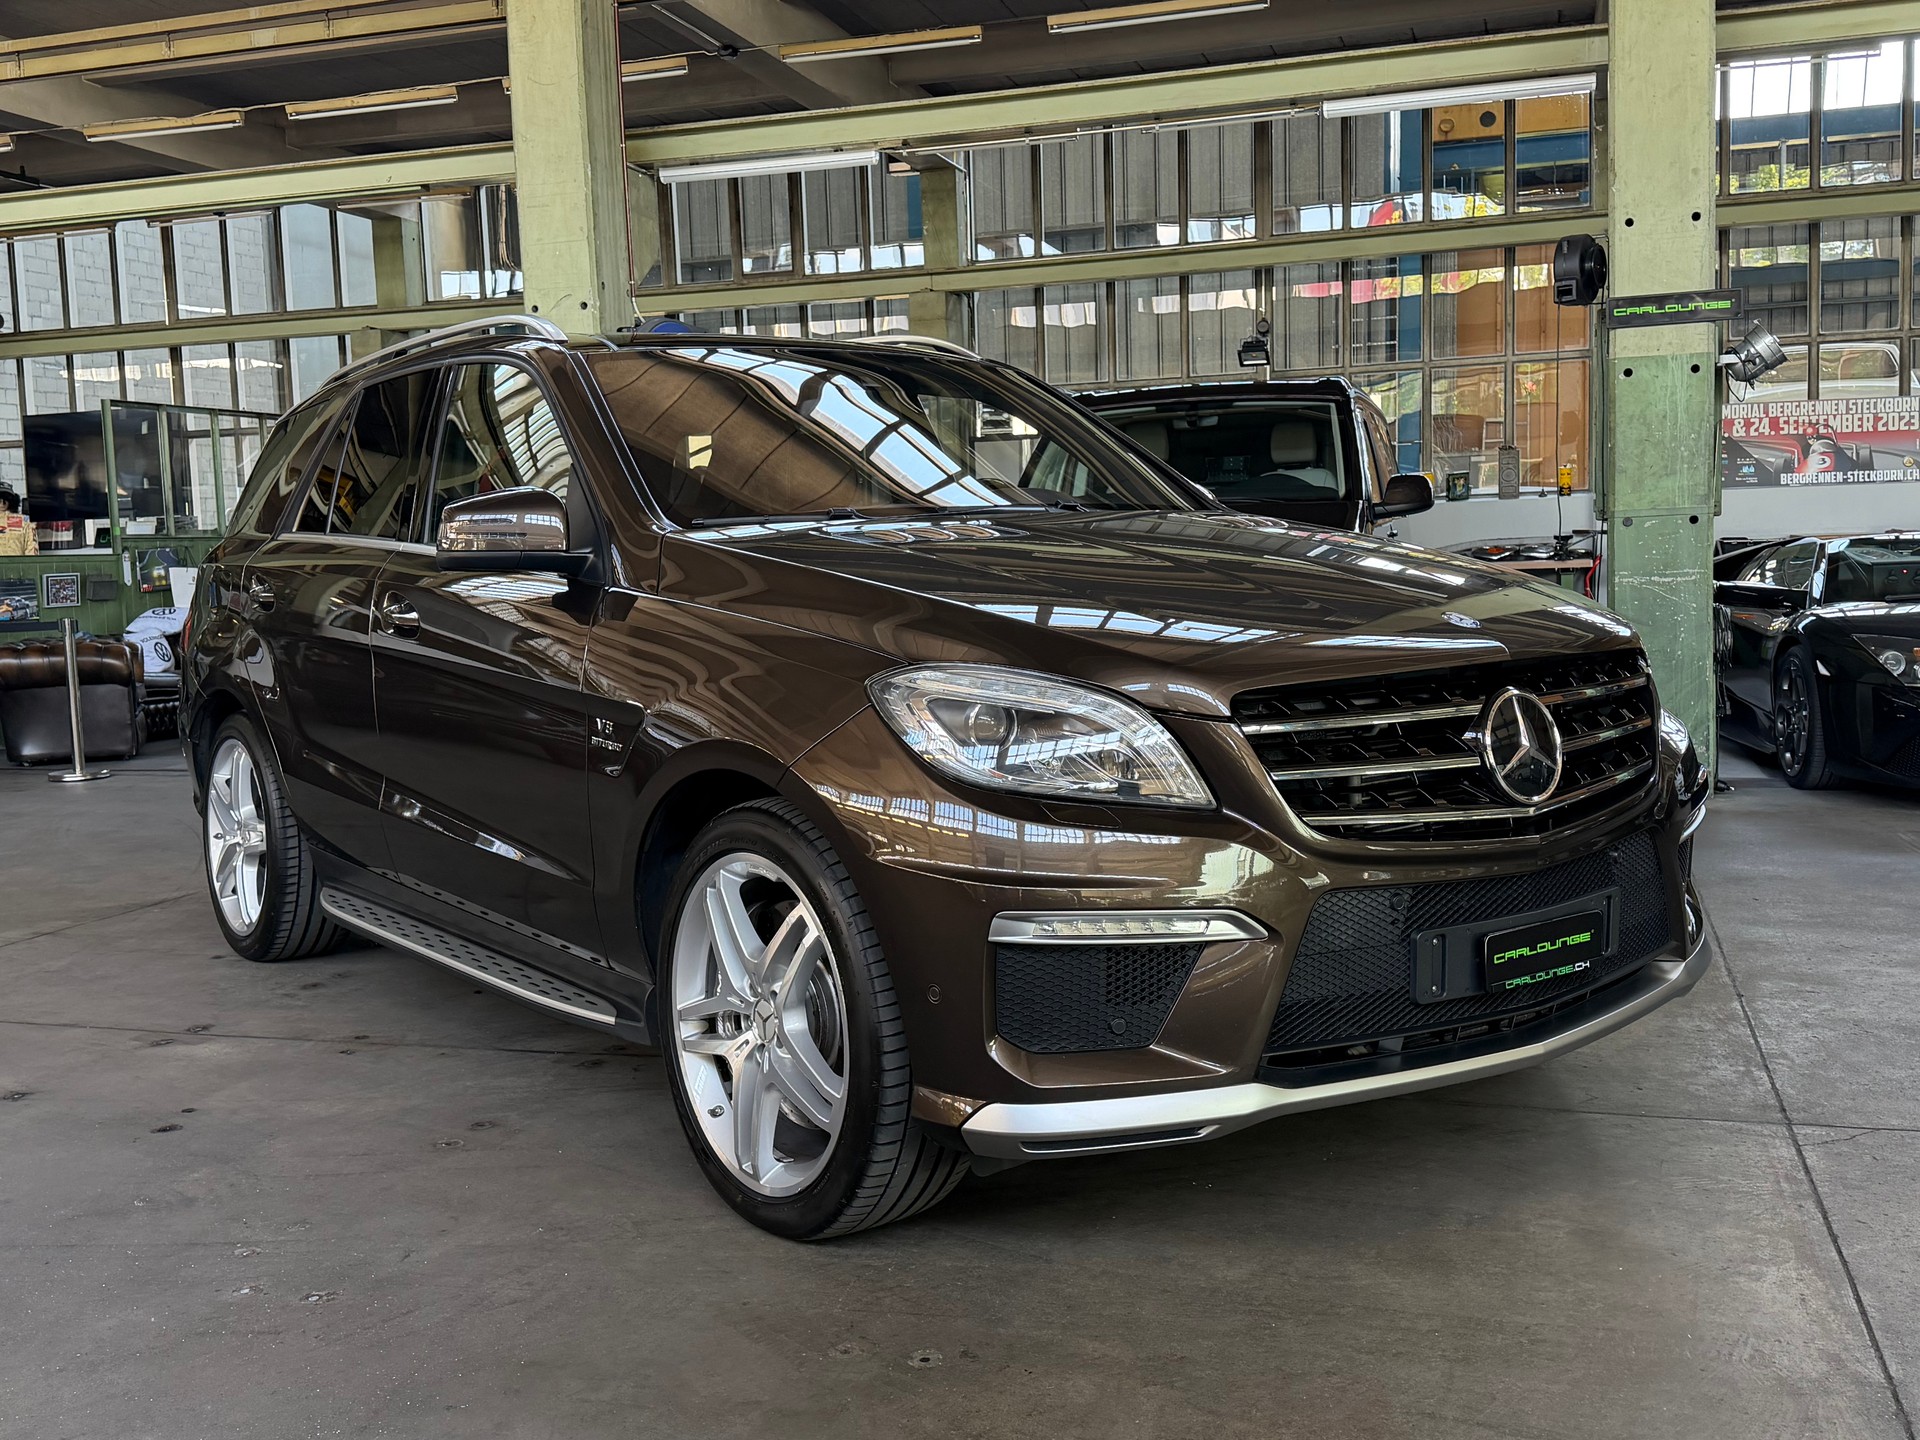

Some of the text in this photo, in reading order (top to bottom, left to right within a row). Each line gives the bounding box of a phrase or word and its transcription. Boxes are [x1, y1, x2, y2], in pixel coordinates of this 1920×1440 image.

[1613, 299, 1731, 317] CARLOUNGE
[1769, 399, 1847, 418] BERGRENNEN
[1849, 396, 1920, 415] STECKBORN
[1732, 418, 1747, 438] &
[1750, 417, 1776, 437] 24.
[1877, 411, 1920, 432] 2023
[1780, 468, 1920, 485] BERGRENNEN-STECKBORN.CH
[1494, 932, 1591, 964] CARLOUNGE
[1505, 959, 1590, 990] CARLOUNGE.CH
